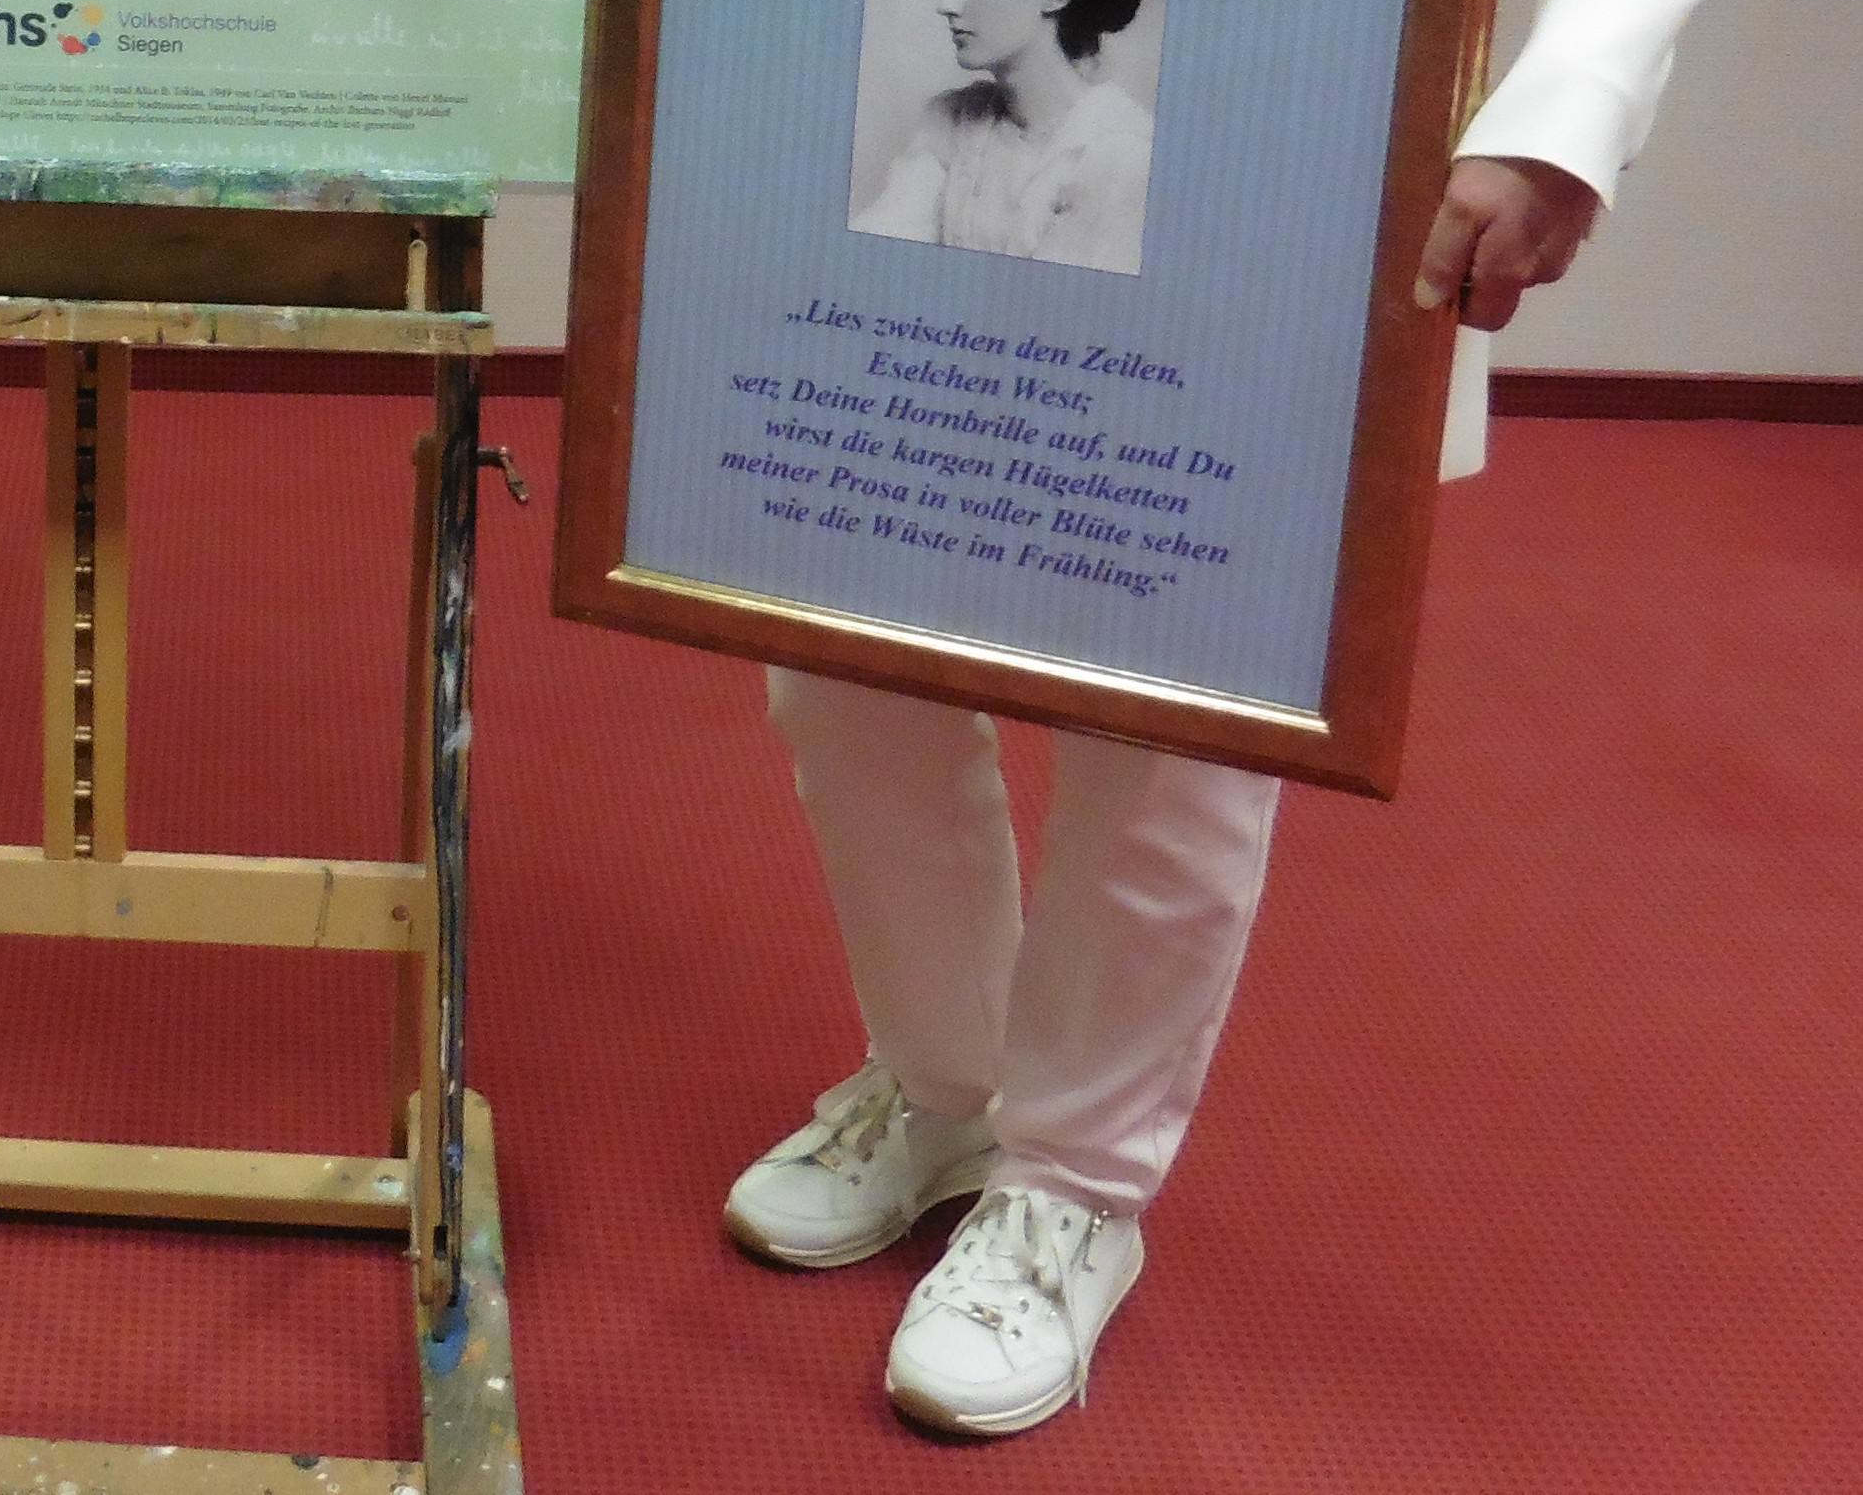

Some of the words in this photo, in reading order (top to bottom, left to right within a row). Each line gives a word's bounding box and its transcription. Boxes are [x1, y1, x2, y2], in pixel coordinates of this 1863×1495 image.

[117, 34, 183, 57] Siegen
[118, 11, 277, 35] Volkshochschule
[865, 351, 1001, 396] Eselchen
[1013, 376, 1093, 415] West;
[872, 316, 1007, 355] zwischen
[1015, 336, 1071, 366] den
[1079, 347, 1185, 388] Zeilen,
[728, 374, 782, 402] setz
[789, 378, 877, 415] Deine
[884, 395, 1040, 445] Hornbrille
[1047, 431, 1108, 461] auf,
[1114, 444, 1180, 470] und
[1185, 450, 1236, 482] Du
[766, 417, 834, 448] wirst
[840, 429, 884, 458] die
[889, 437, 994, 479] kargen
[1003, 458, 1191, 515] Hügelketten
[718, 446, 821, 483] meiner
[828, 466, 910, 503] Prosa
[917, 483, 948, 510] in
[959, 496, 1042, 527] voller
[1050, 508, 1132, 547] Blüte
[1139, 532, 1233, 564] sehen
[761, 497, 810, 525] wie
[815, 505, 862, 534] die
[872, 514, 959, 553] Wüste
[966, 533, 1005, 564] im
